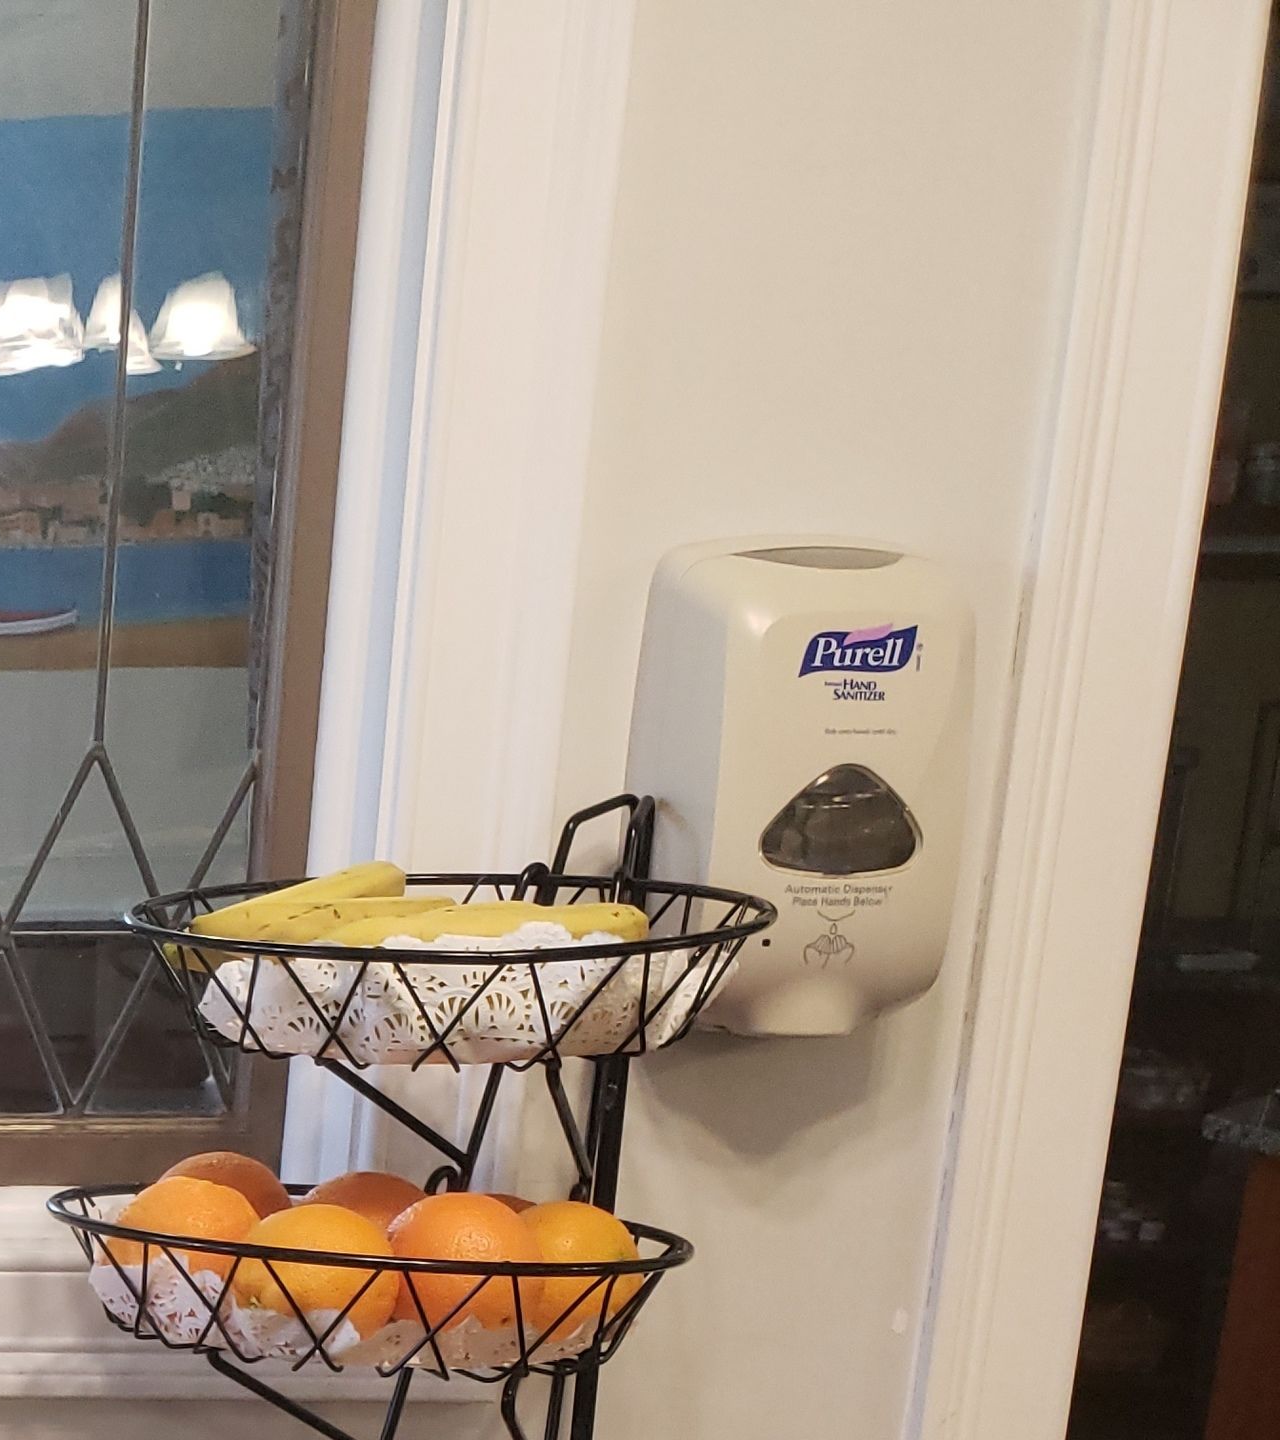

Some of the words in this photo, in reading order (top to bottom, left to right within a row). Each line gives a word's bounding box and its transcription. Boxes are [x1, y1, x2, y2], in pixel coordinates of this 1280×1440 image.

[810, 637, 904, 667] Purell
[843, 678, 877, 690] HAND
[832, 689, 886, 701] SANITIZER
[784, 884, 840, 894] Automatic
